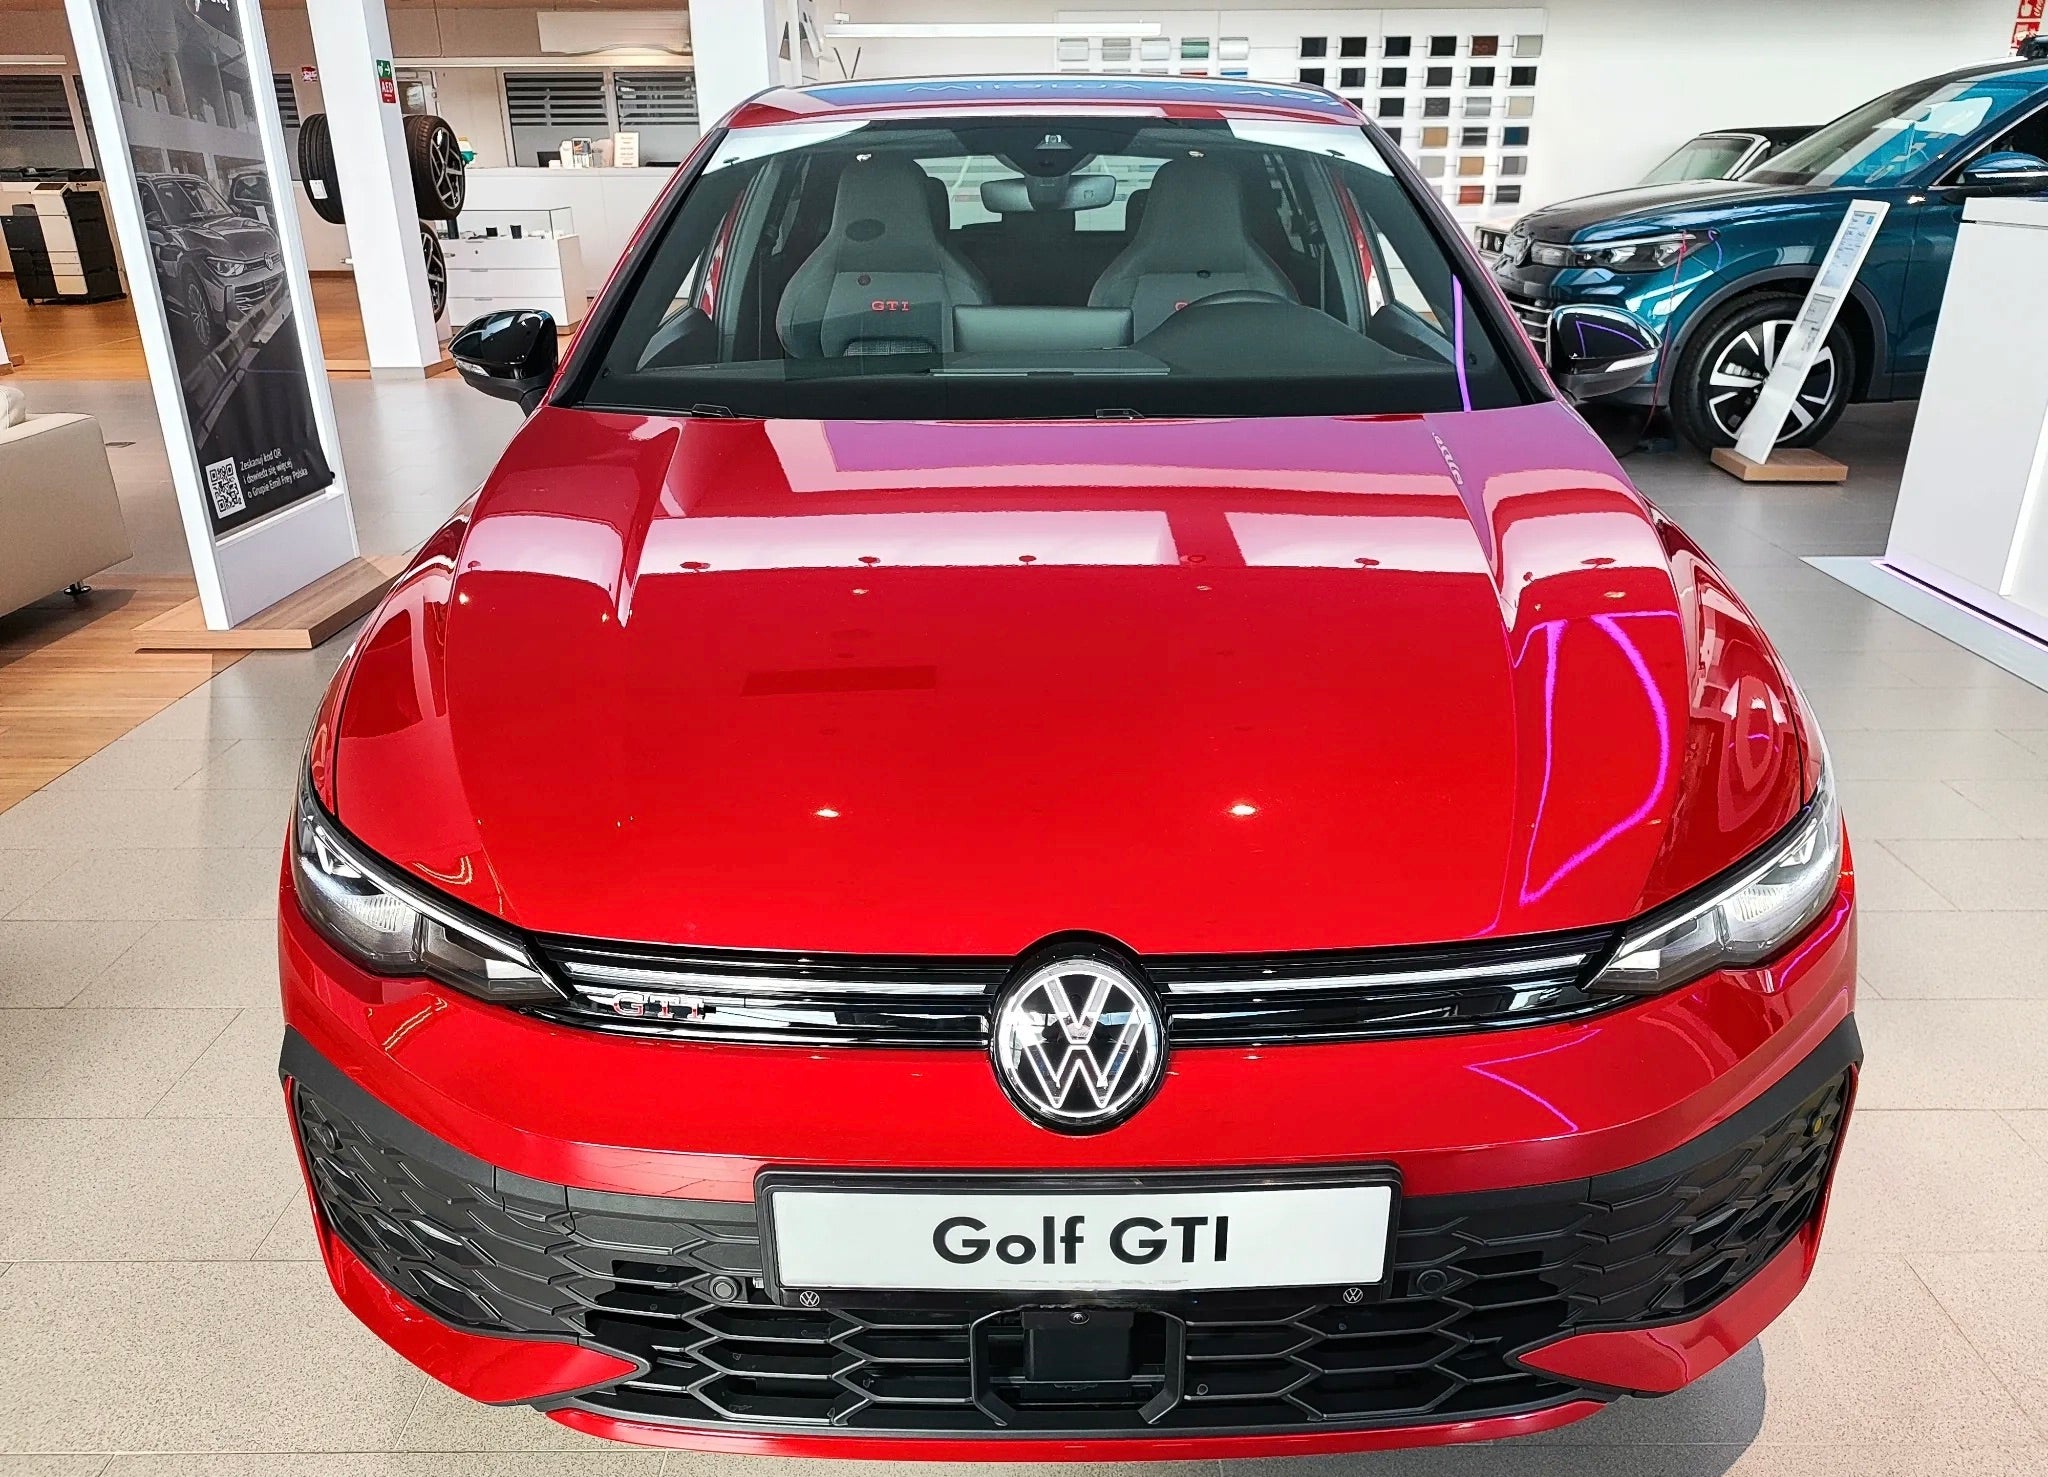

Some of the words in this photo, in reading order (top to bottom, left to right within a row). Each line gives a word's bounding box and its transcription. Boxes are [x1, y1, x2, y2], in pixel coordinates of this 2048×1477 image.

[381, 81, 394, 93] AED
[871, 300, 910, 311] GTI
[240, 454, 264, 471] Zeskanuj
[262, 451, 274, 462] kod
[273, 448, 282, 459] QR
[246, 467, 268, 483] dowiedz
[268, 465, 277, 476] się
[275, 457, 293, 472] więcej
[252, 483, 270, 496] Grupie
[269, 476, 281, 490] Emil
[280, 475, 293, 485] Frey
[291, 467, 308, 480] Polska
[613, 992, 705, 1020] GTI
[933, 1215, 1085, 1266] Golf
[1109, 1215, 1229, 1266] GTI
